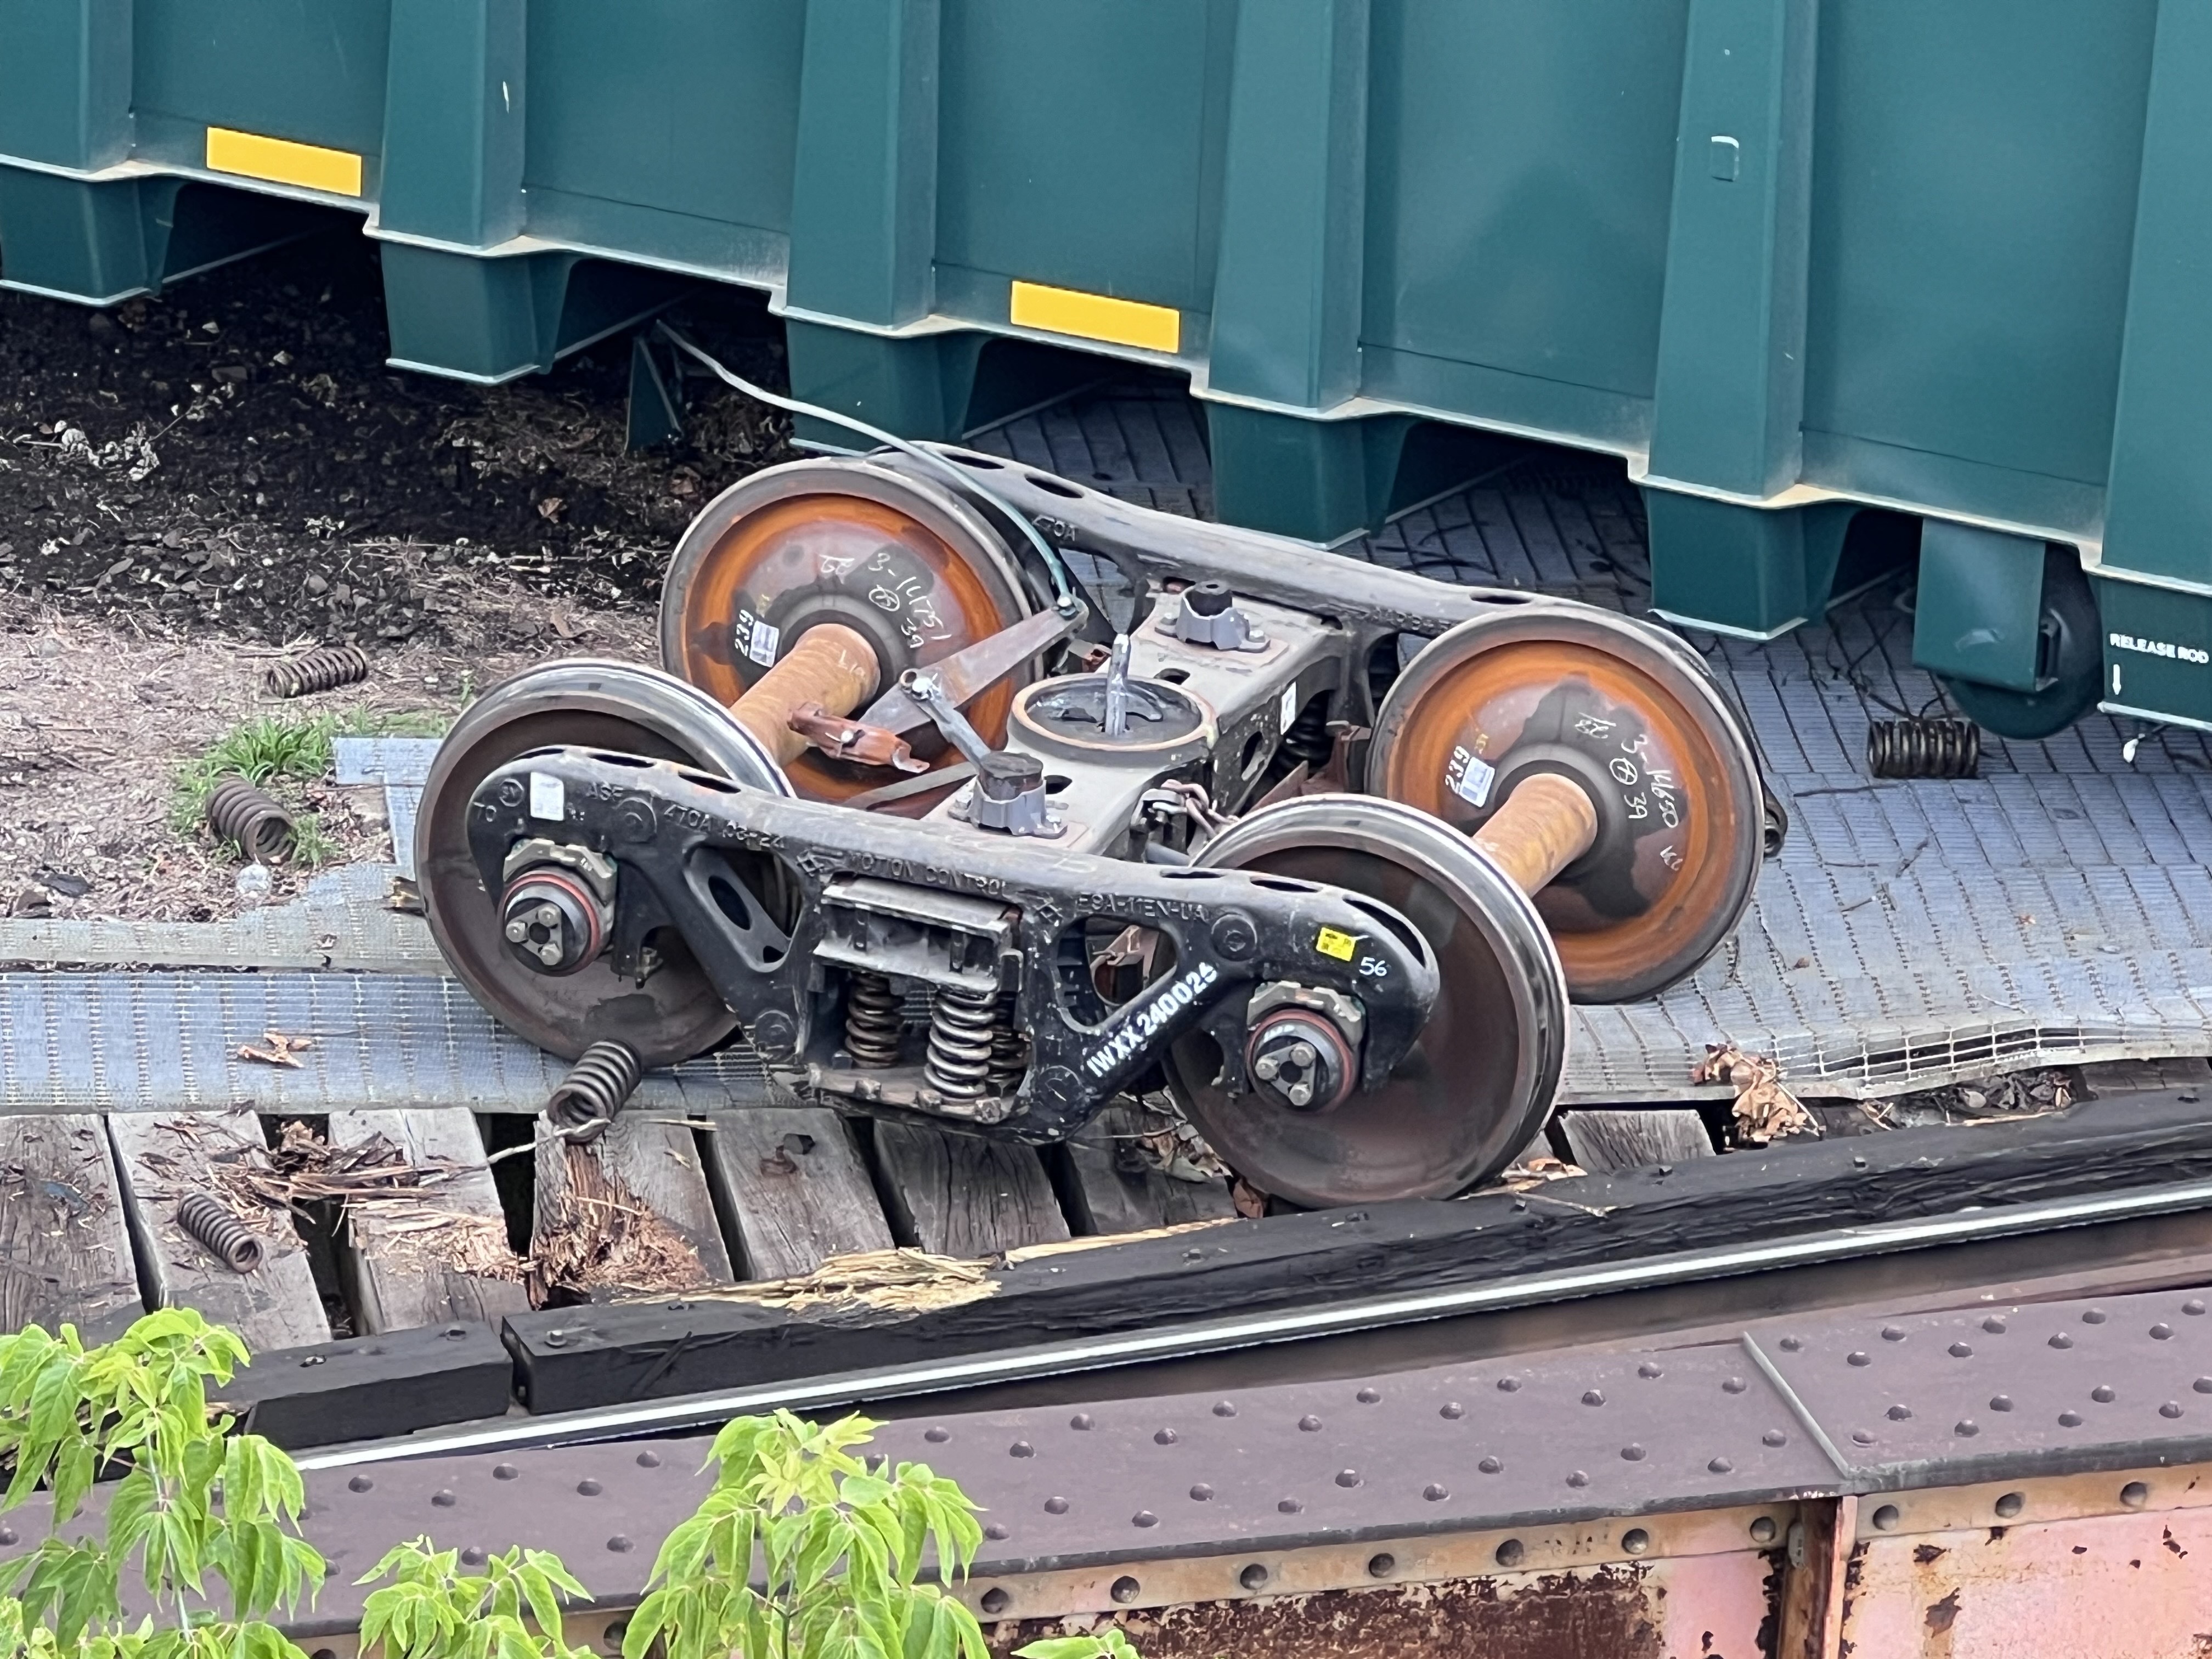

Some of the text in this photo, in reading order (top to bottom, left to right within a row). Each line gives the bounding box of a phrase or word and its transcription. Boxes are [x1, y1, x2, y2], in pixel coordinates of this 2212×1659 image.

[734, 609, 754, 657] 239
[2109, 633, 2209, 664] RELEASE ROD
[1444, 746, 1470, 794] 239
[1359, 956, 1387, 977] 56
[1086, 1025, 1144, 1078] IWXX
